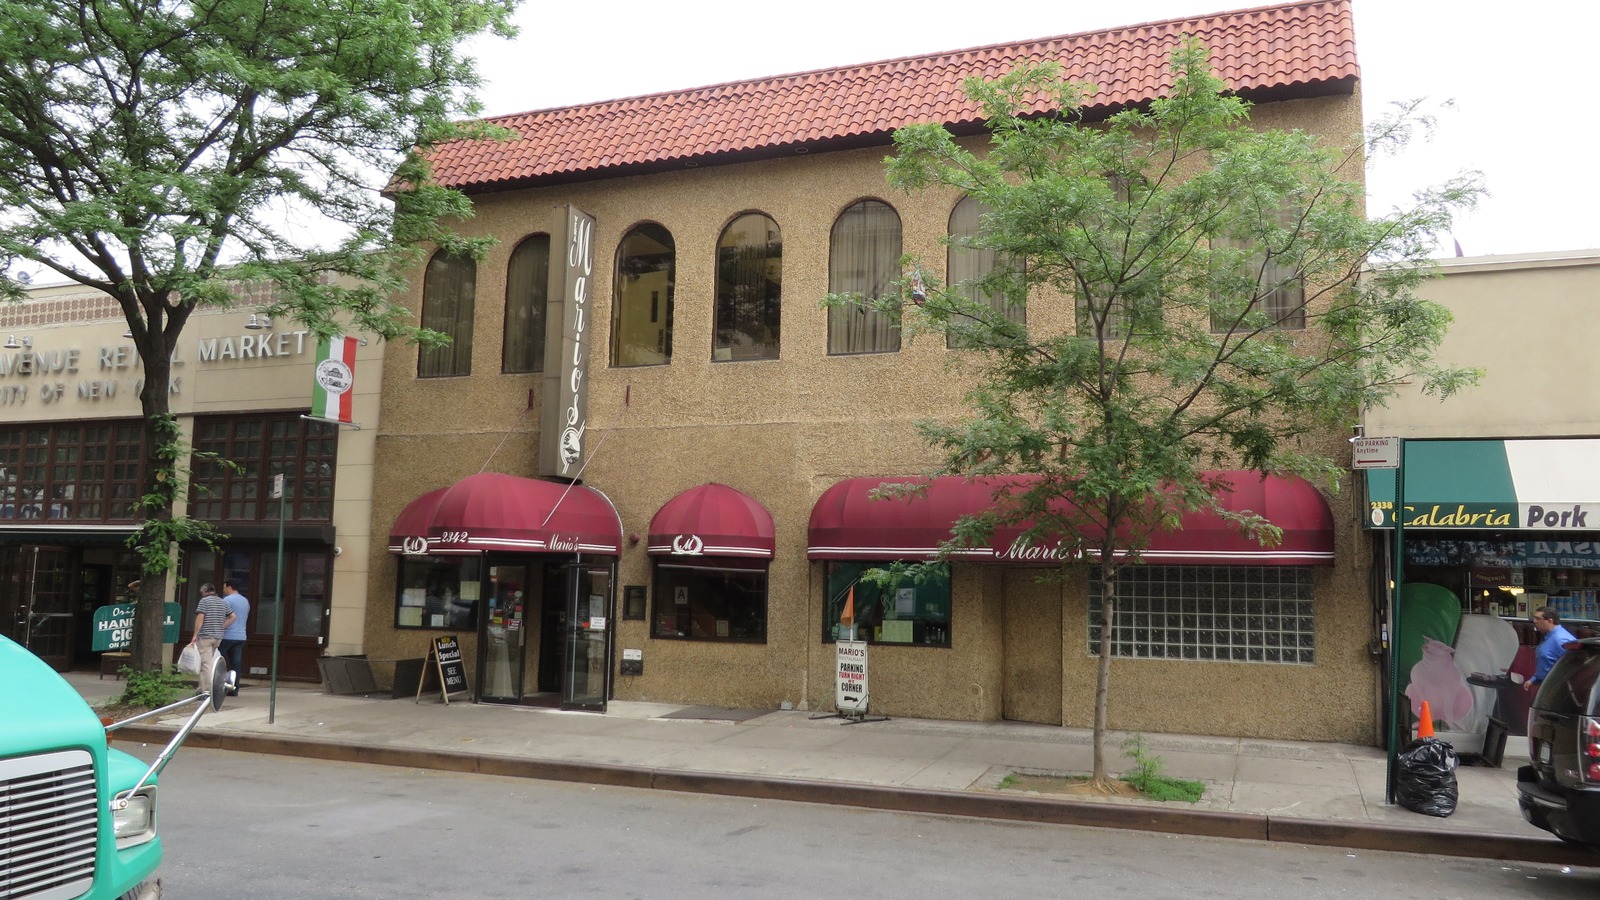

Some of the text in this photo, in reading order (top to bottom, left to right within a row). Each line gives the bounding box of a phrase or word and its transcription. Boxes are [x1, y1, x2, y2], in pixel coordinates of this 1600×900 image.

[99, 345, 184, 368] RETL
[199, 330, 308, 361] MARKET
[0, 376, 181, 404] ITY OF NEW YK
[1370, 501, 1393, 509] 2338
[1391, 504, 1588, 527] Calabria Pork
[441, 531, 468, 543] 2342
[543, 533, 579, 551] Mario's
[677, 590, 686, 600] A
[438, 640, 457, 649] Lunch
[439, 650, 460, 661] Special
[838, 647, 865, 657] MARIO'S
[447, 667, 457, 675] SEE
[840, 663, 863, 673] PARKING
[446, 676, 461, 685] MENU
[841, 682, 863, 693] CORNER
